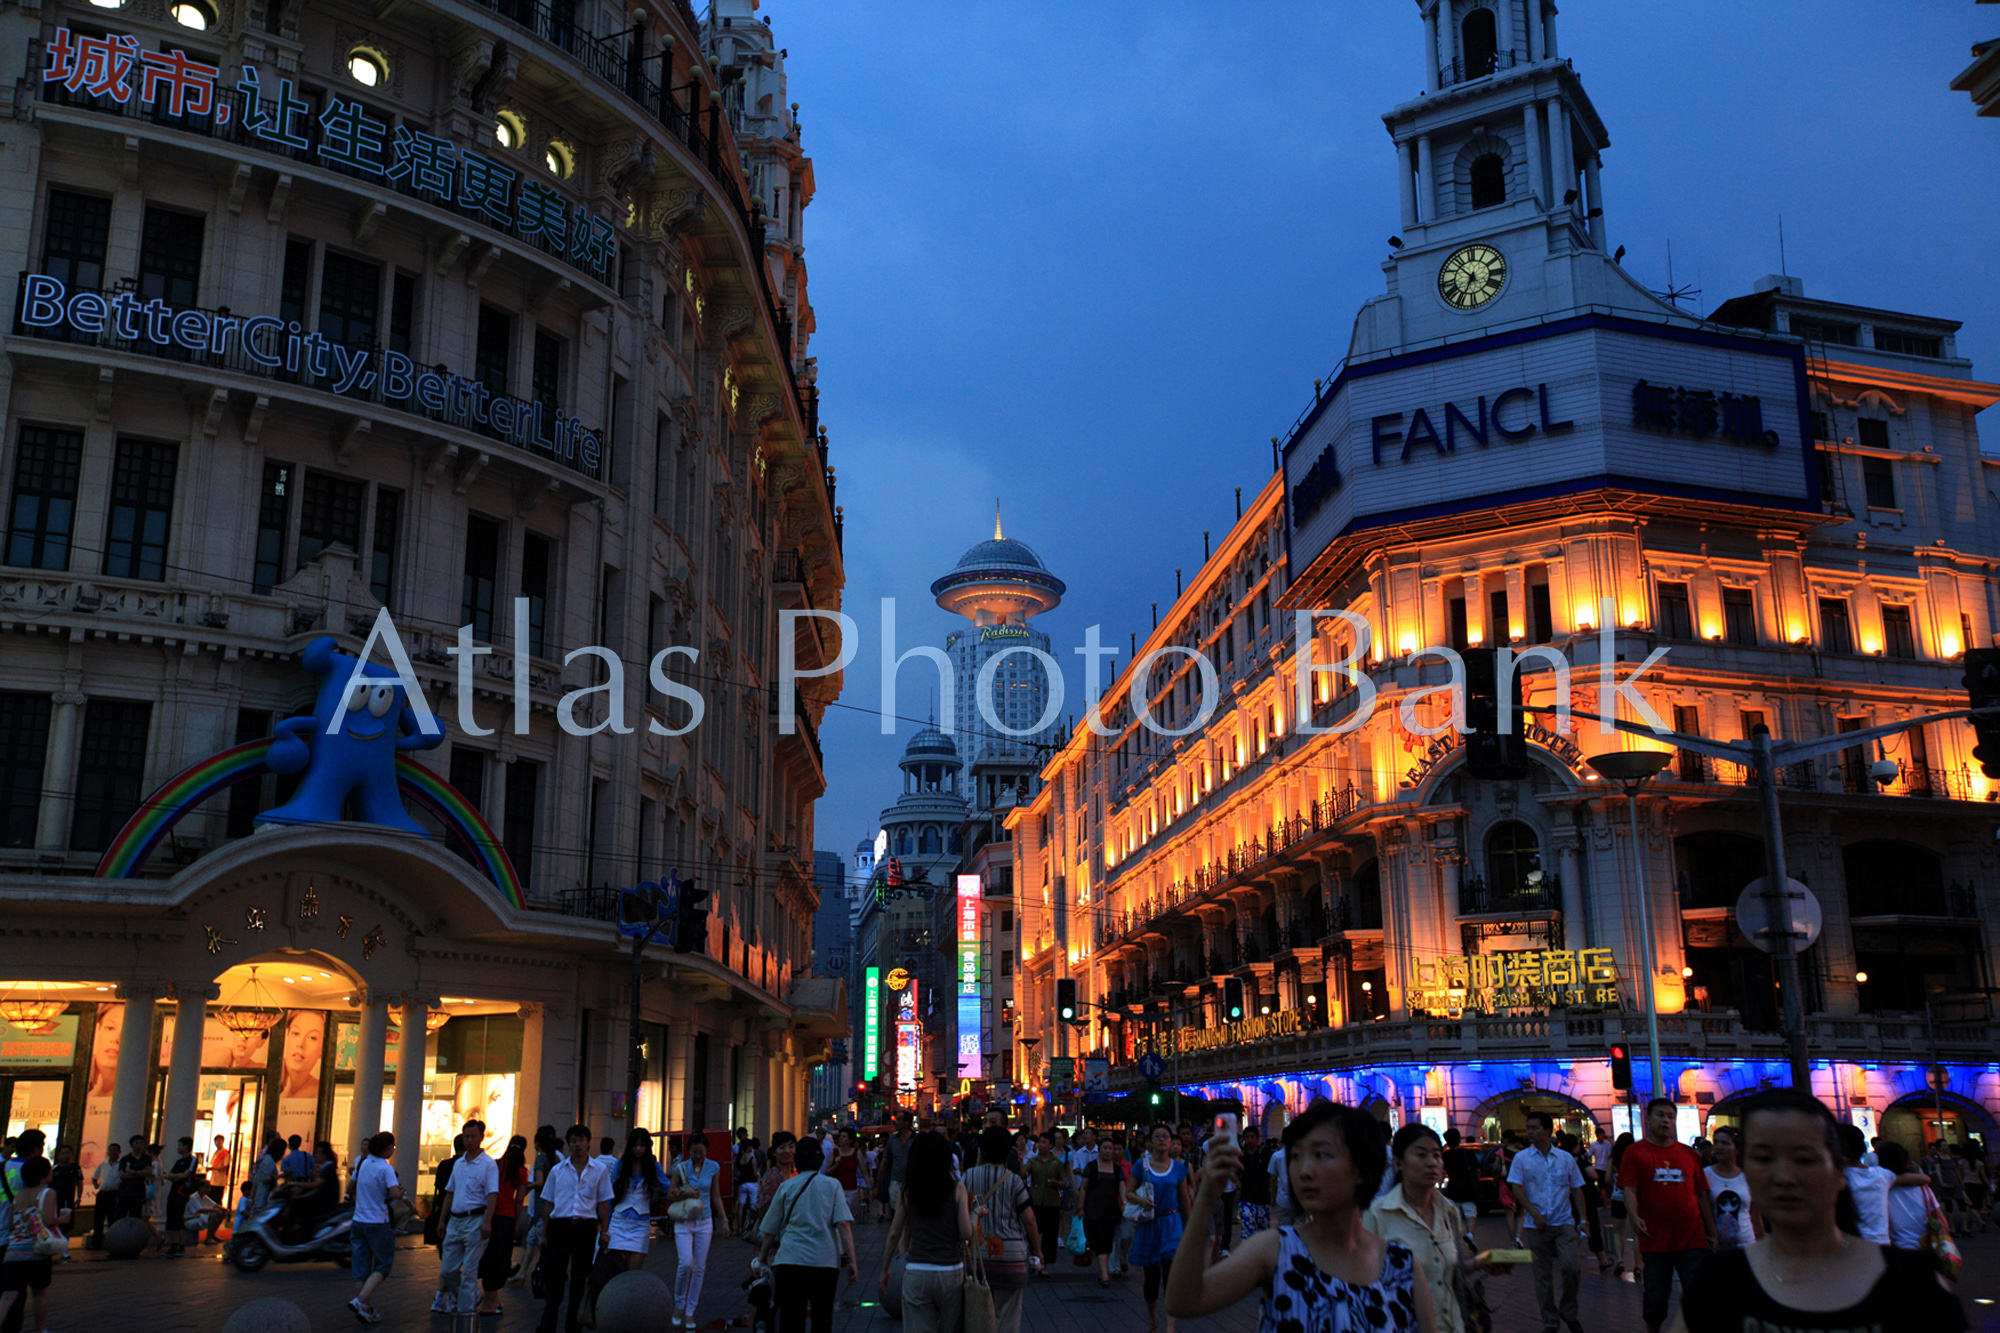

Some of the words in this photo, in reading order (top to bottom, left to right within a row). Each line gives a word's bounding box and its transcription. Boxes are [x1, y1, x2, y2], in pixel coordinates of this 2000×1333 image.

[1371, 382, 1573, 465] FANCL
[980, 624, 1030, 642] Radisson
[1406, 734, 1454, 784] EAST
[1405, 948, 1616, 991] 上海时装商店
[1405, 993, 1483, 1010] SHANGHAI
[1565, 987, 1619, 1004] STRE
[1193, 1024, 1228, 1050] SHANGHAI
[1231, 1015, 1266, 1042] FASHION
